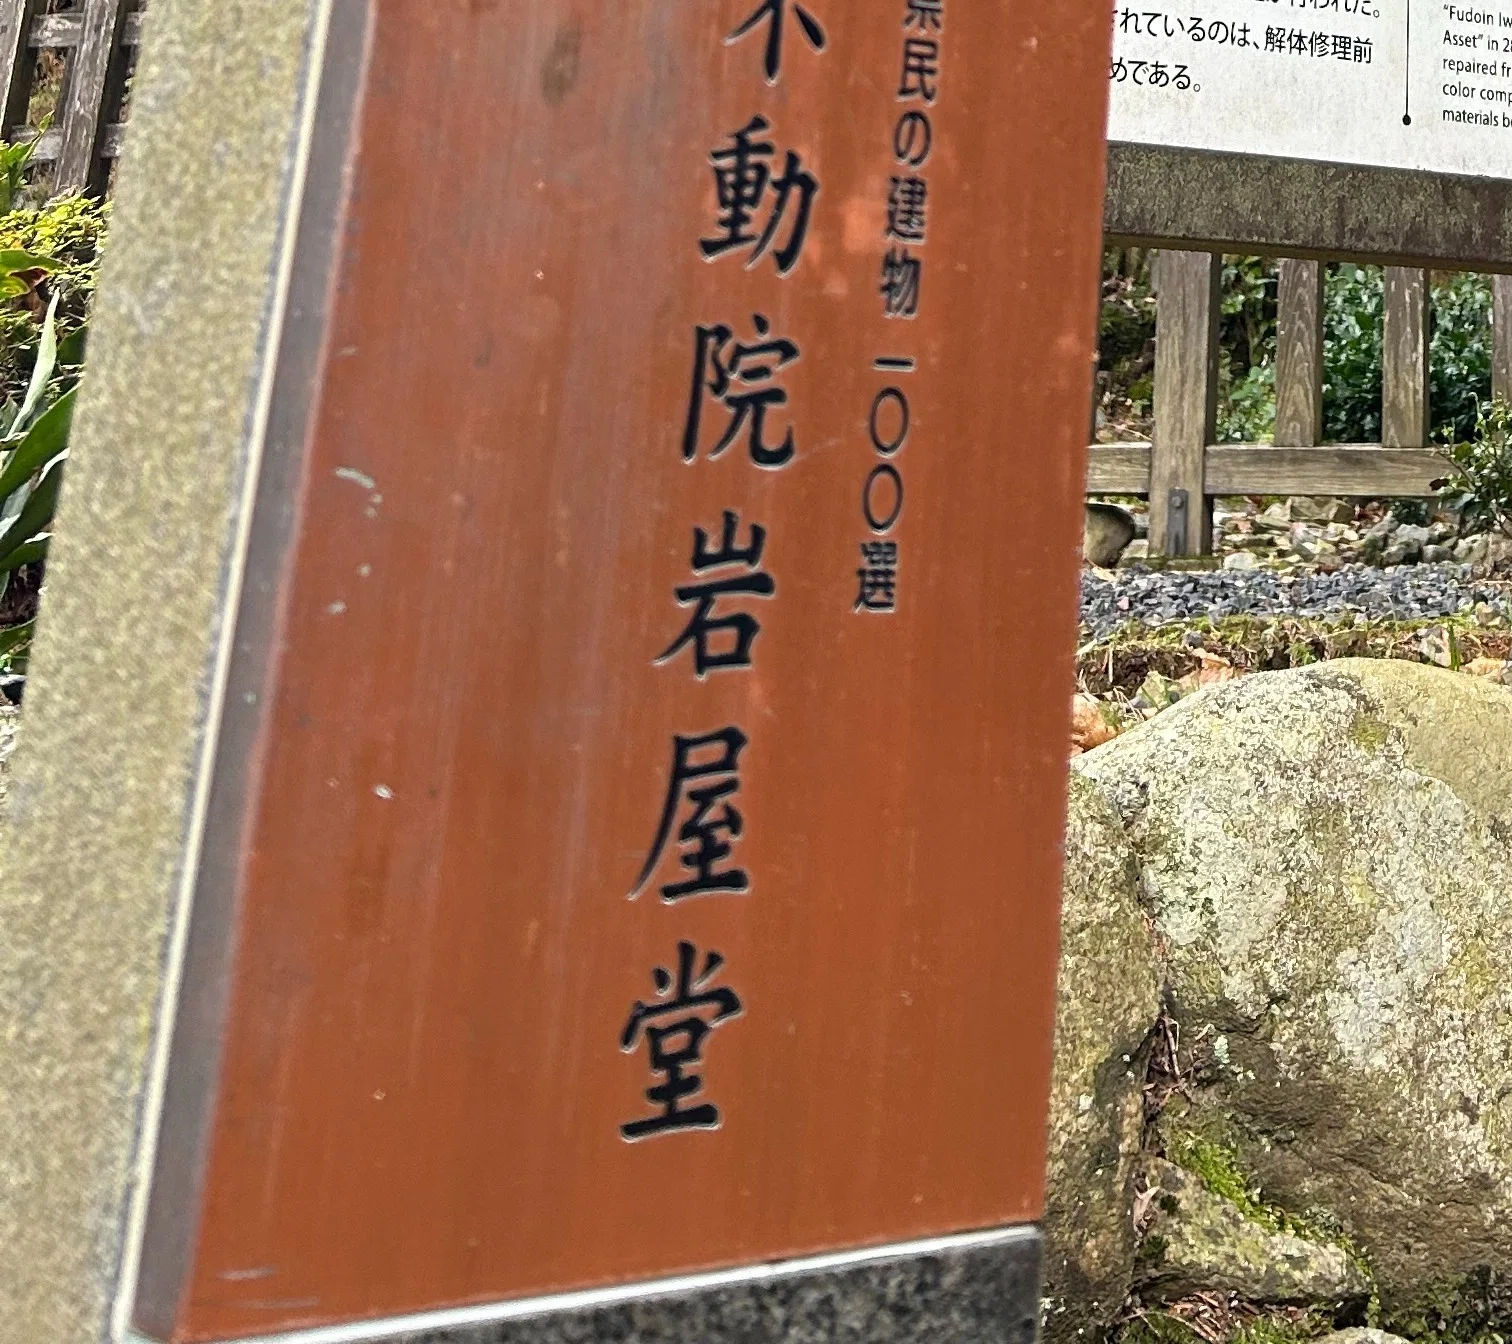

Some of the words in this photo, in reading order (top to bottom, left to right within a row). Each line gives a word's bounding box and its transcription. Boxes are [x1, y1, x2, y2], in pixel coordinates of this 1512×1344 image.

[1111, 4, 1373, 64] れているのは、解体修理前
[1486, 33, 1500, 53] in
[1441, 79, 1478, 100] color
[1441, 108, 1500, 128] materials
